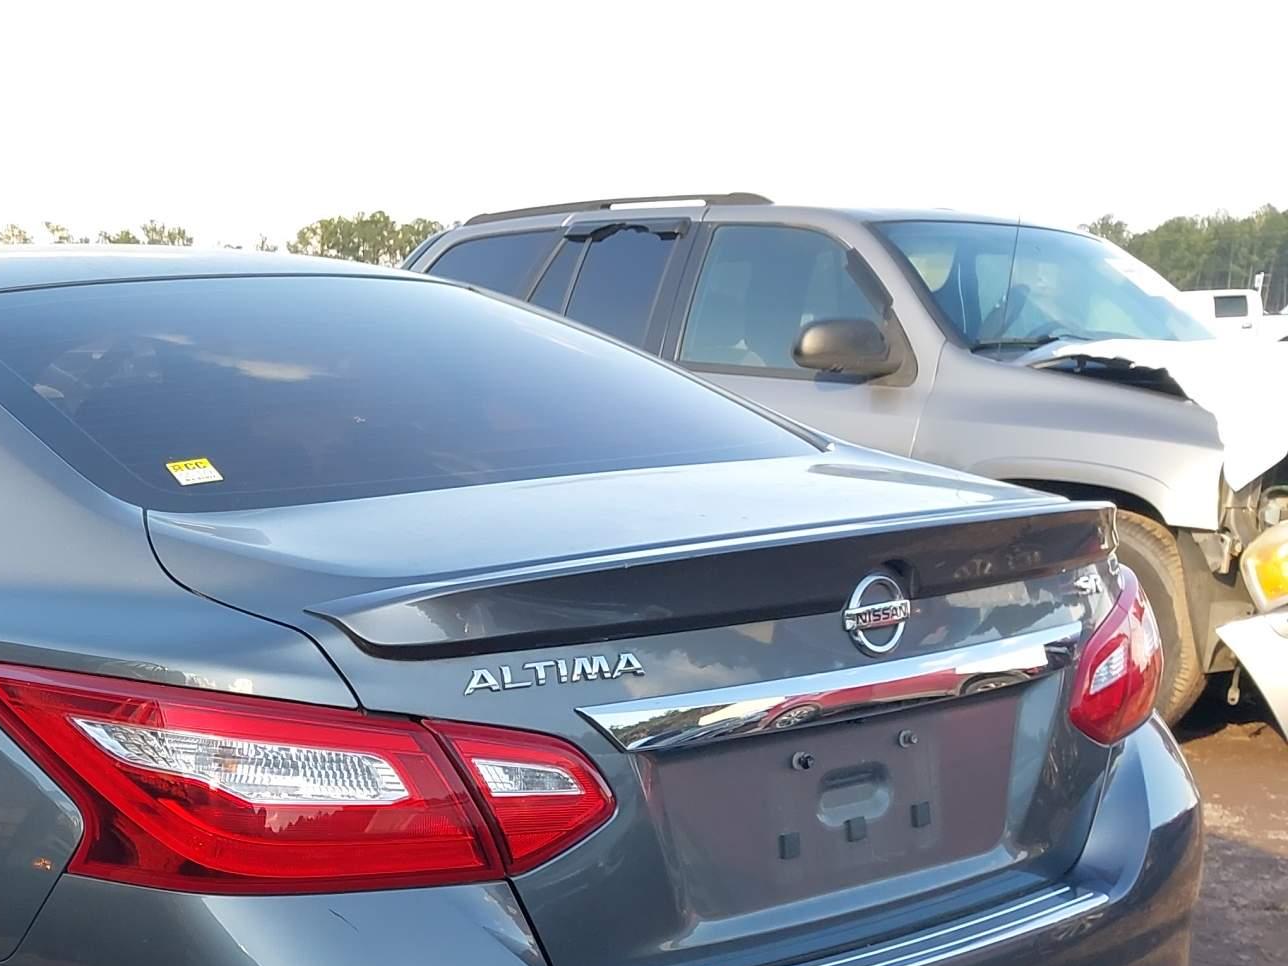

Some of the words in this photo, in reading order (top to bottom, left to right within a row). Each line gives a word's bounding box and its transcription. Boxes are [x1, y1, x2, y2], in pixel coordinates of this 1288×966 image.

[1073, 574, 1103, 595] SR
[855, 602, 909, 625] NISSAN
[463, 652, 646, 697] ALTIMA
